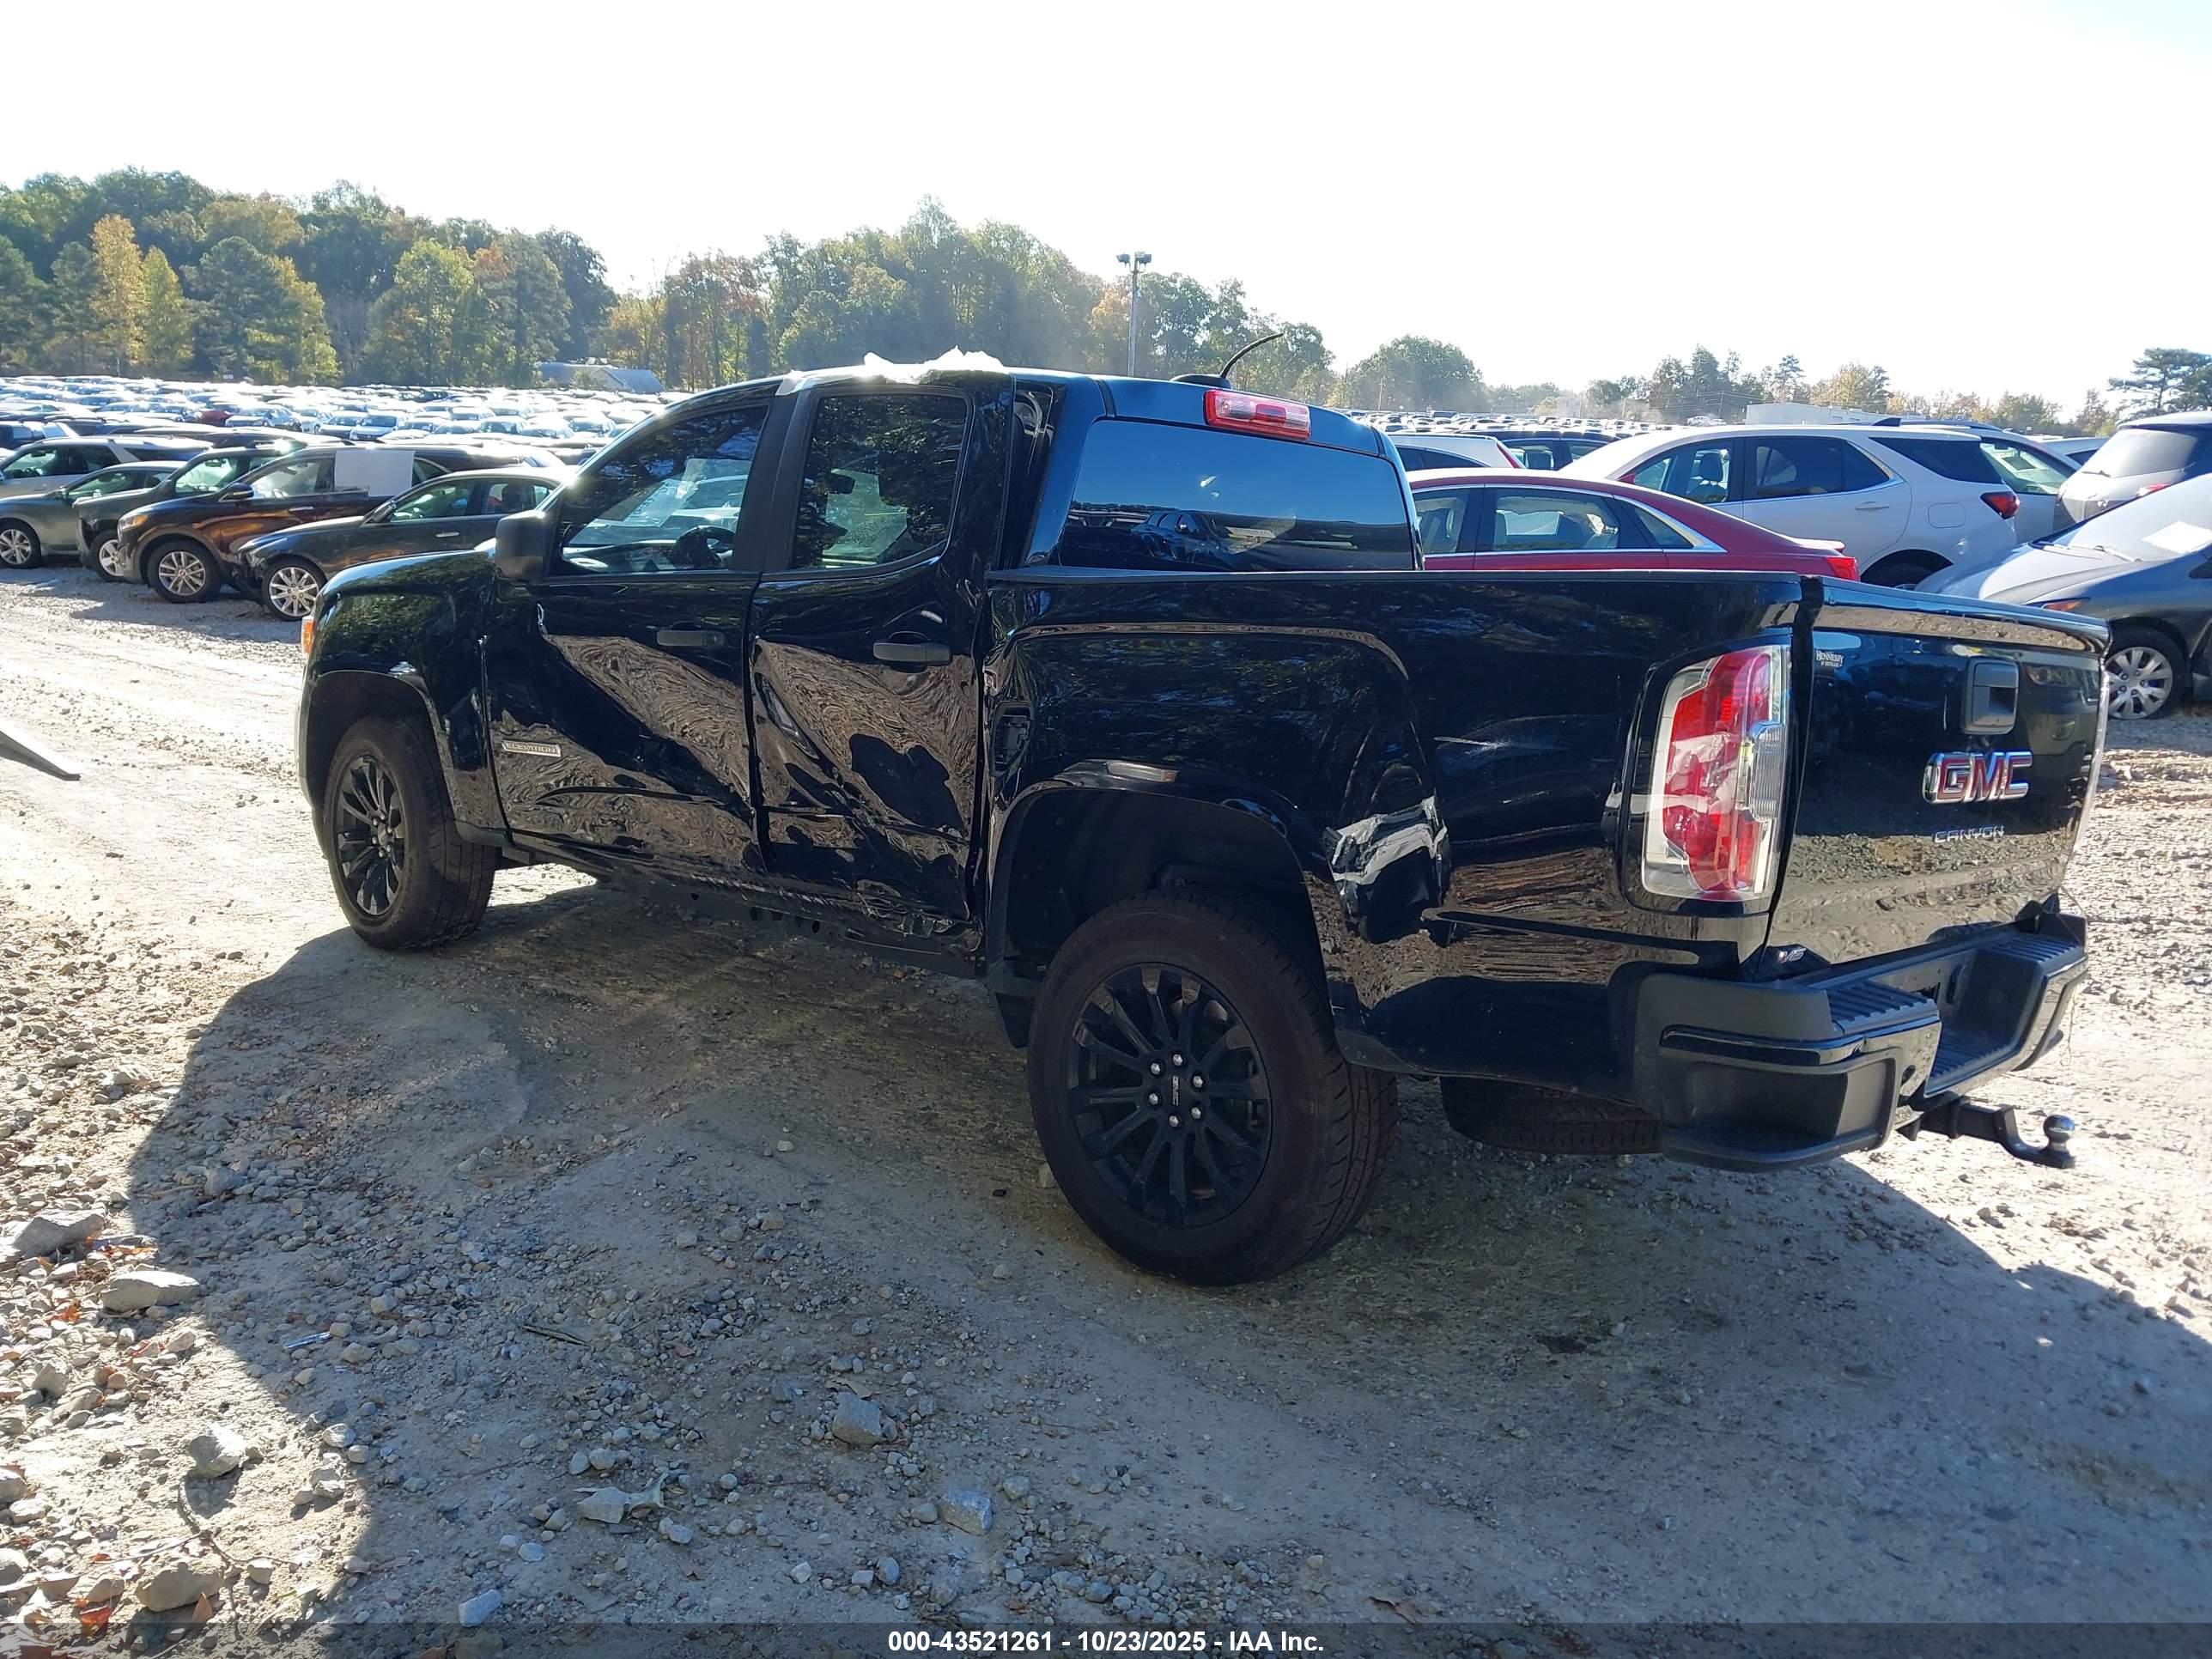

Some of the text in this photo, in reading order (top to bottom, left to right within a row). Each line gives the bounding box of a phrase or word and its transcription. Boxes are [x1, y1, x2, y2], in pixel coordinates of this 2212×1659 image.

[506, 741, 557, 754] ELEVATION
[1923, 751, 2033, 804] GMC
[1933, 825, 2005, 843] CANYON
